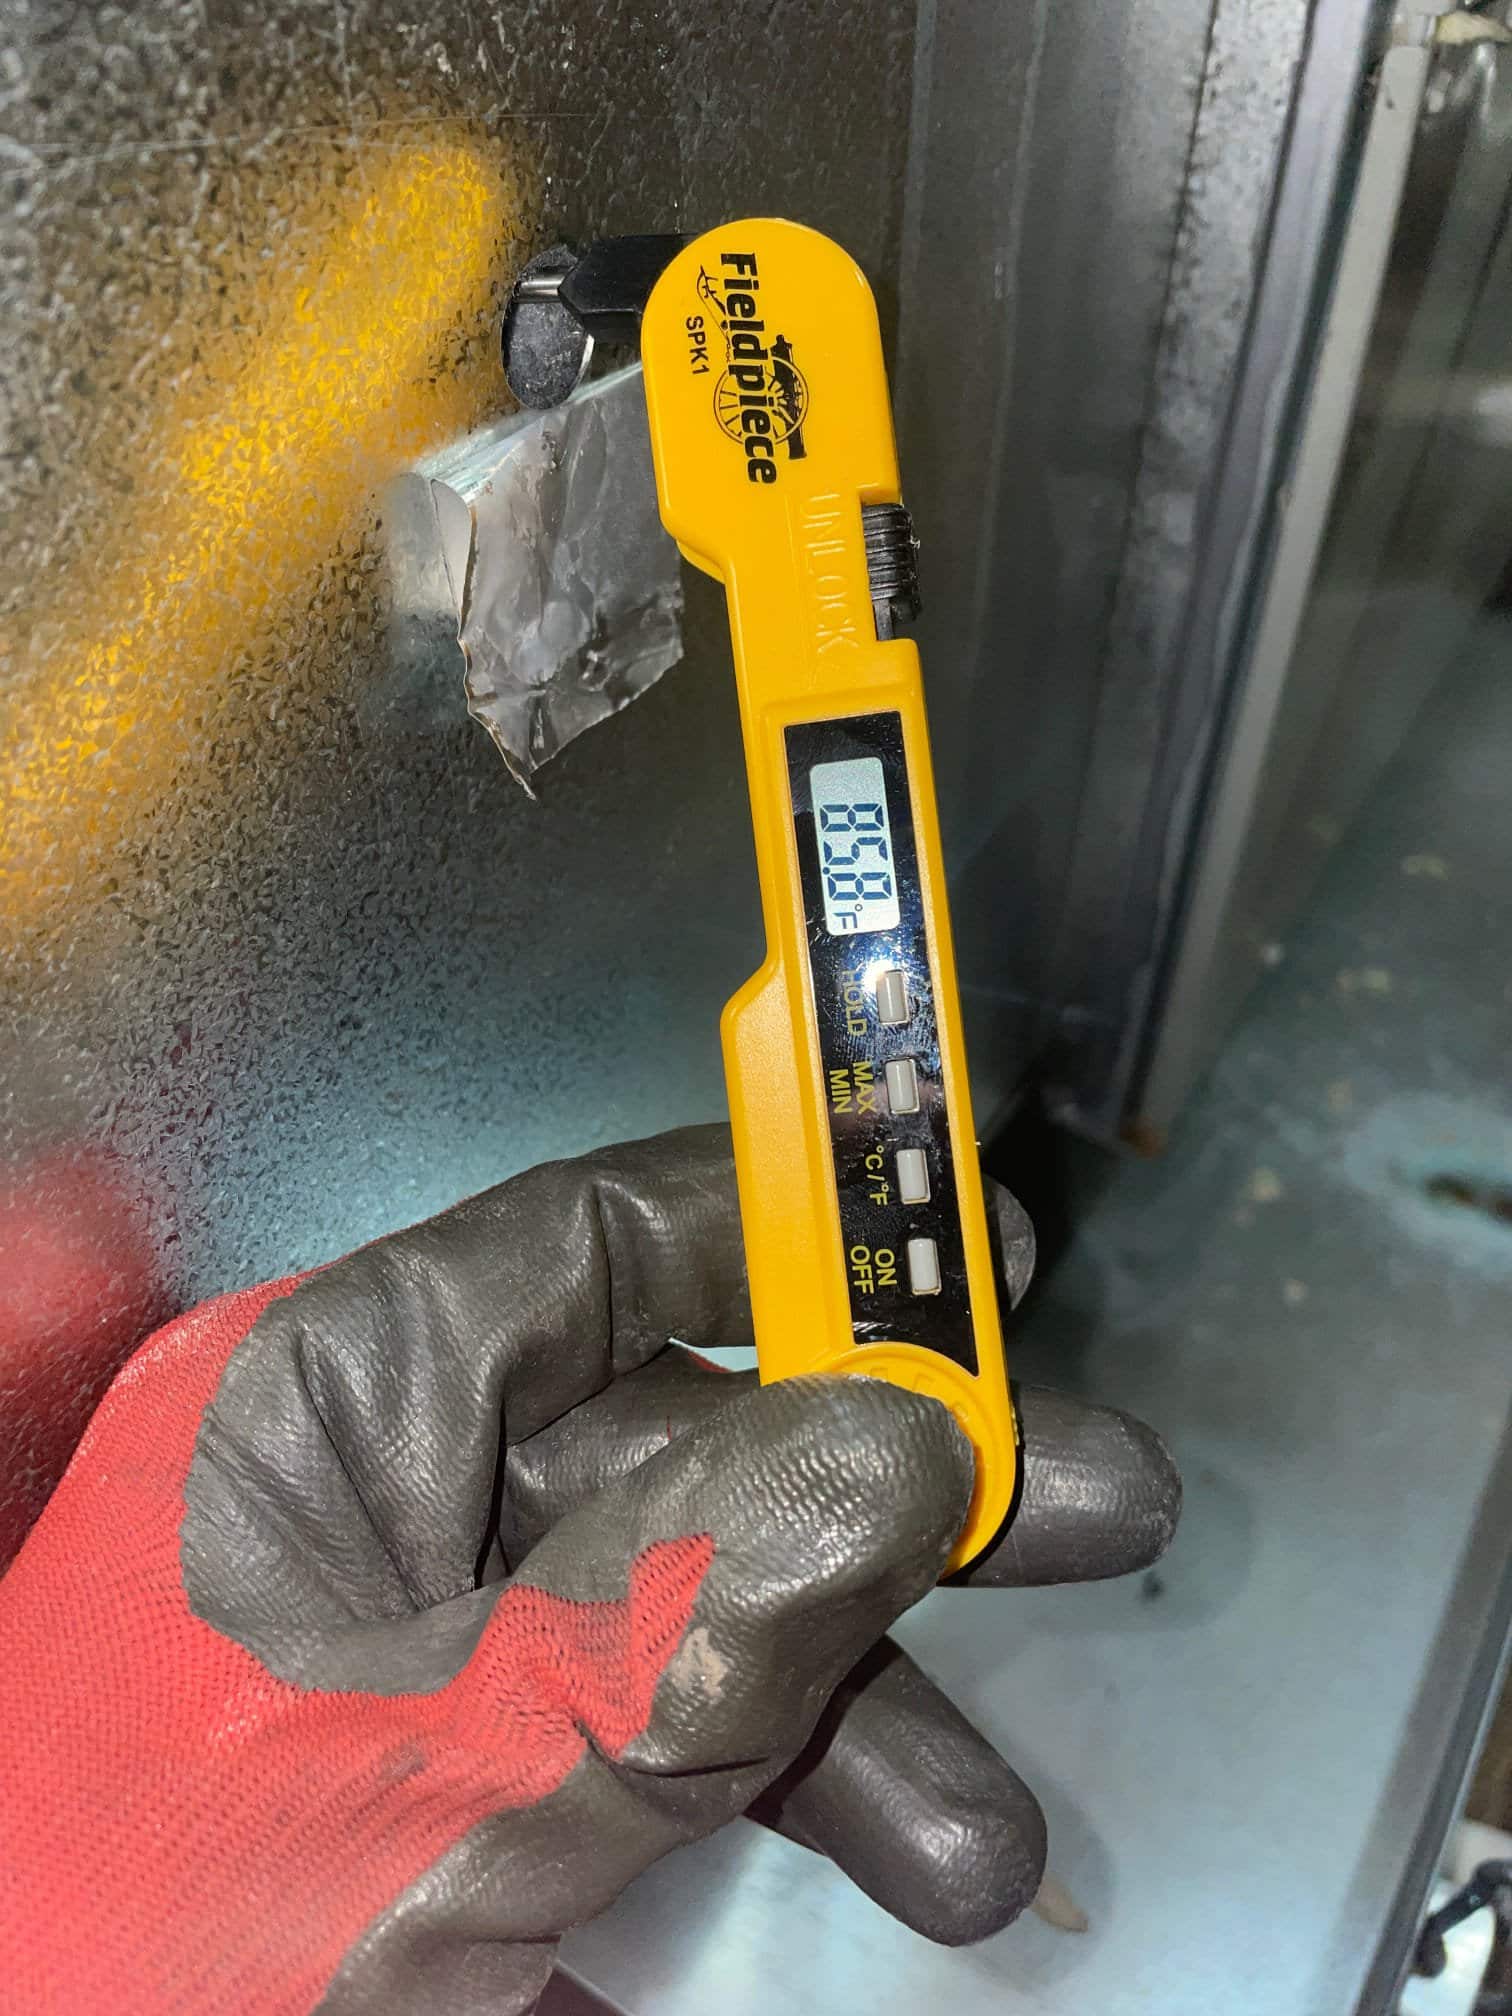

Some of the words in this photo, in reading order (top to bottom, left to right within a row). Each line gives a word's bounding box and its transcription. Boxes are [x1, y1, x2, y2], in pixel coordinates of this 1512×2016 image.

[685, 315, 710, 374] SPK1
[720, 253, 777, 484] Fieldpiece
[801, 494, 859, 654] UNLOCK
[819, 803, 892, 900] 85.8
[842, 970, 867, 1036] HOLD
[829, 1069, 852, 1114] MIN
[852, 1060, 877, 1114] MAX
[850, 1245, 875, 1294] OFF
[874, 1249, 897, 1286] ON
